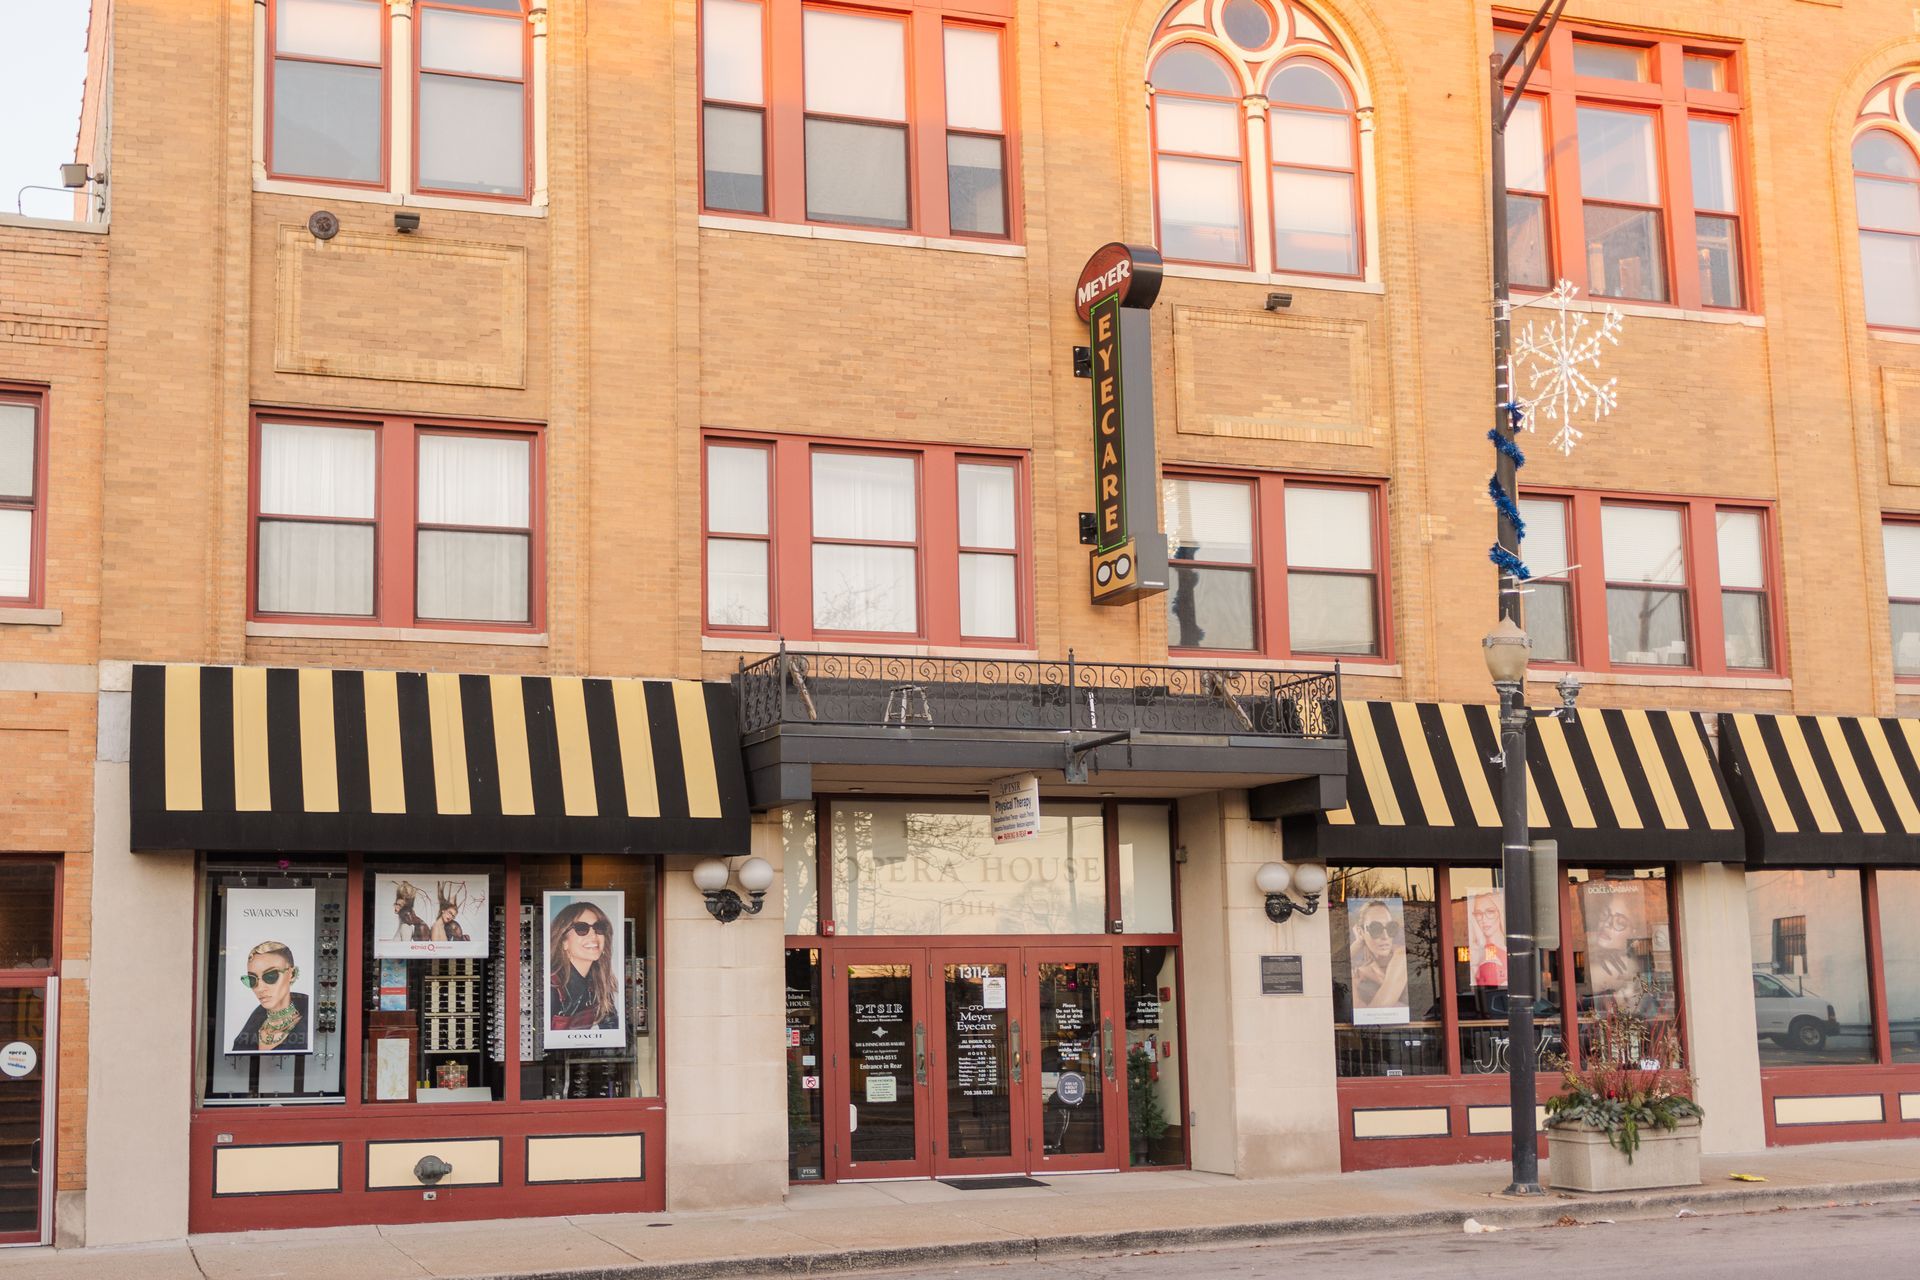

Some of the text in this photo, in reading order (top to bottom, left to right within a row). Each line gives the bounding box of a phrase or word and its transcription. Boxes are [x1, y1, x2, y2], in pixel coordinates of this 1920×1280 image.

[1078, 259, 1130, 307] MEYER
[1098, 313, 1119, 533] EYECARE
[995, 796, 1032, 814] Physical Therapy
[980, 856, 1102, 882] HOUSE
[243, 909, 299, 918] SWAROVSKI
[949, 900, 995, 916] 13114
[959, 966, 990, 978] 13114
[855, 1004, 904, 1014] PTSIR
[960, 1011, 992, 1022] Meyer
[956, 1021, 997, 1032] Eyecare
